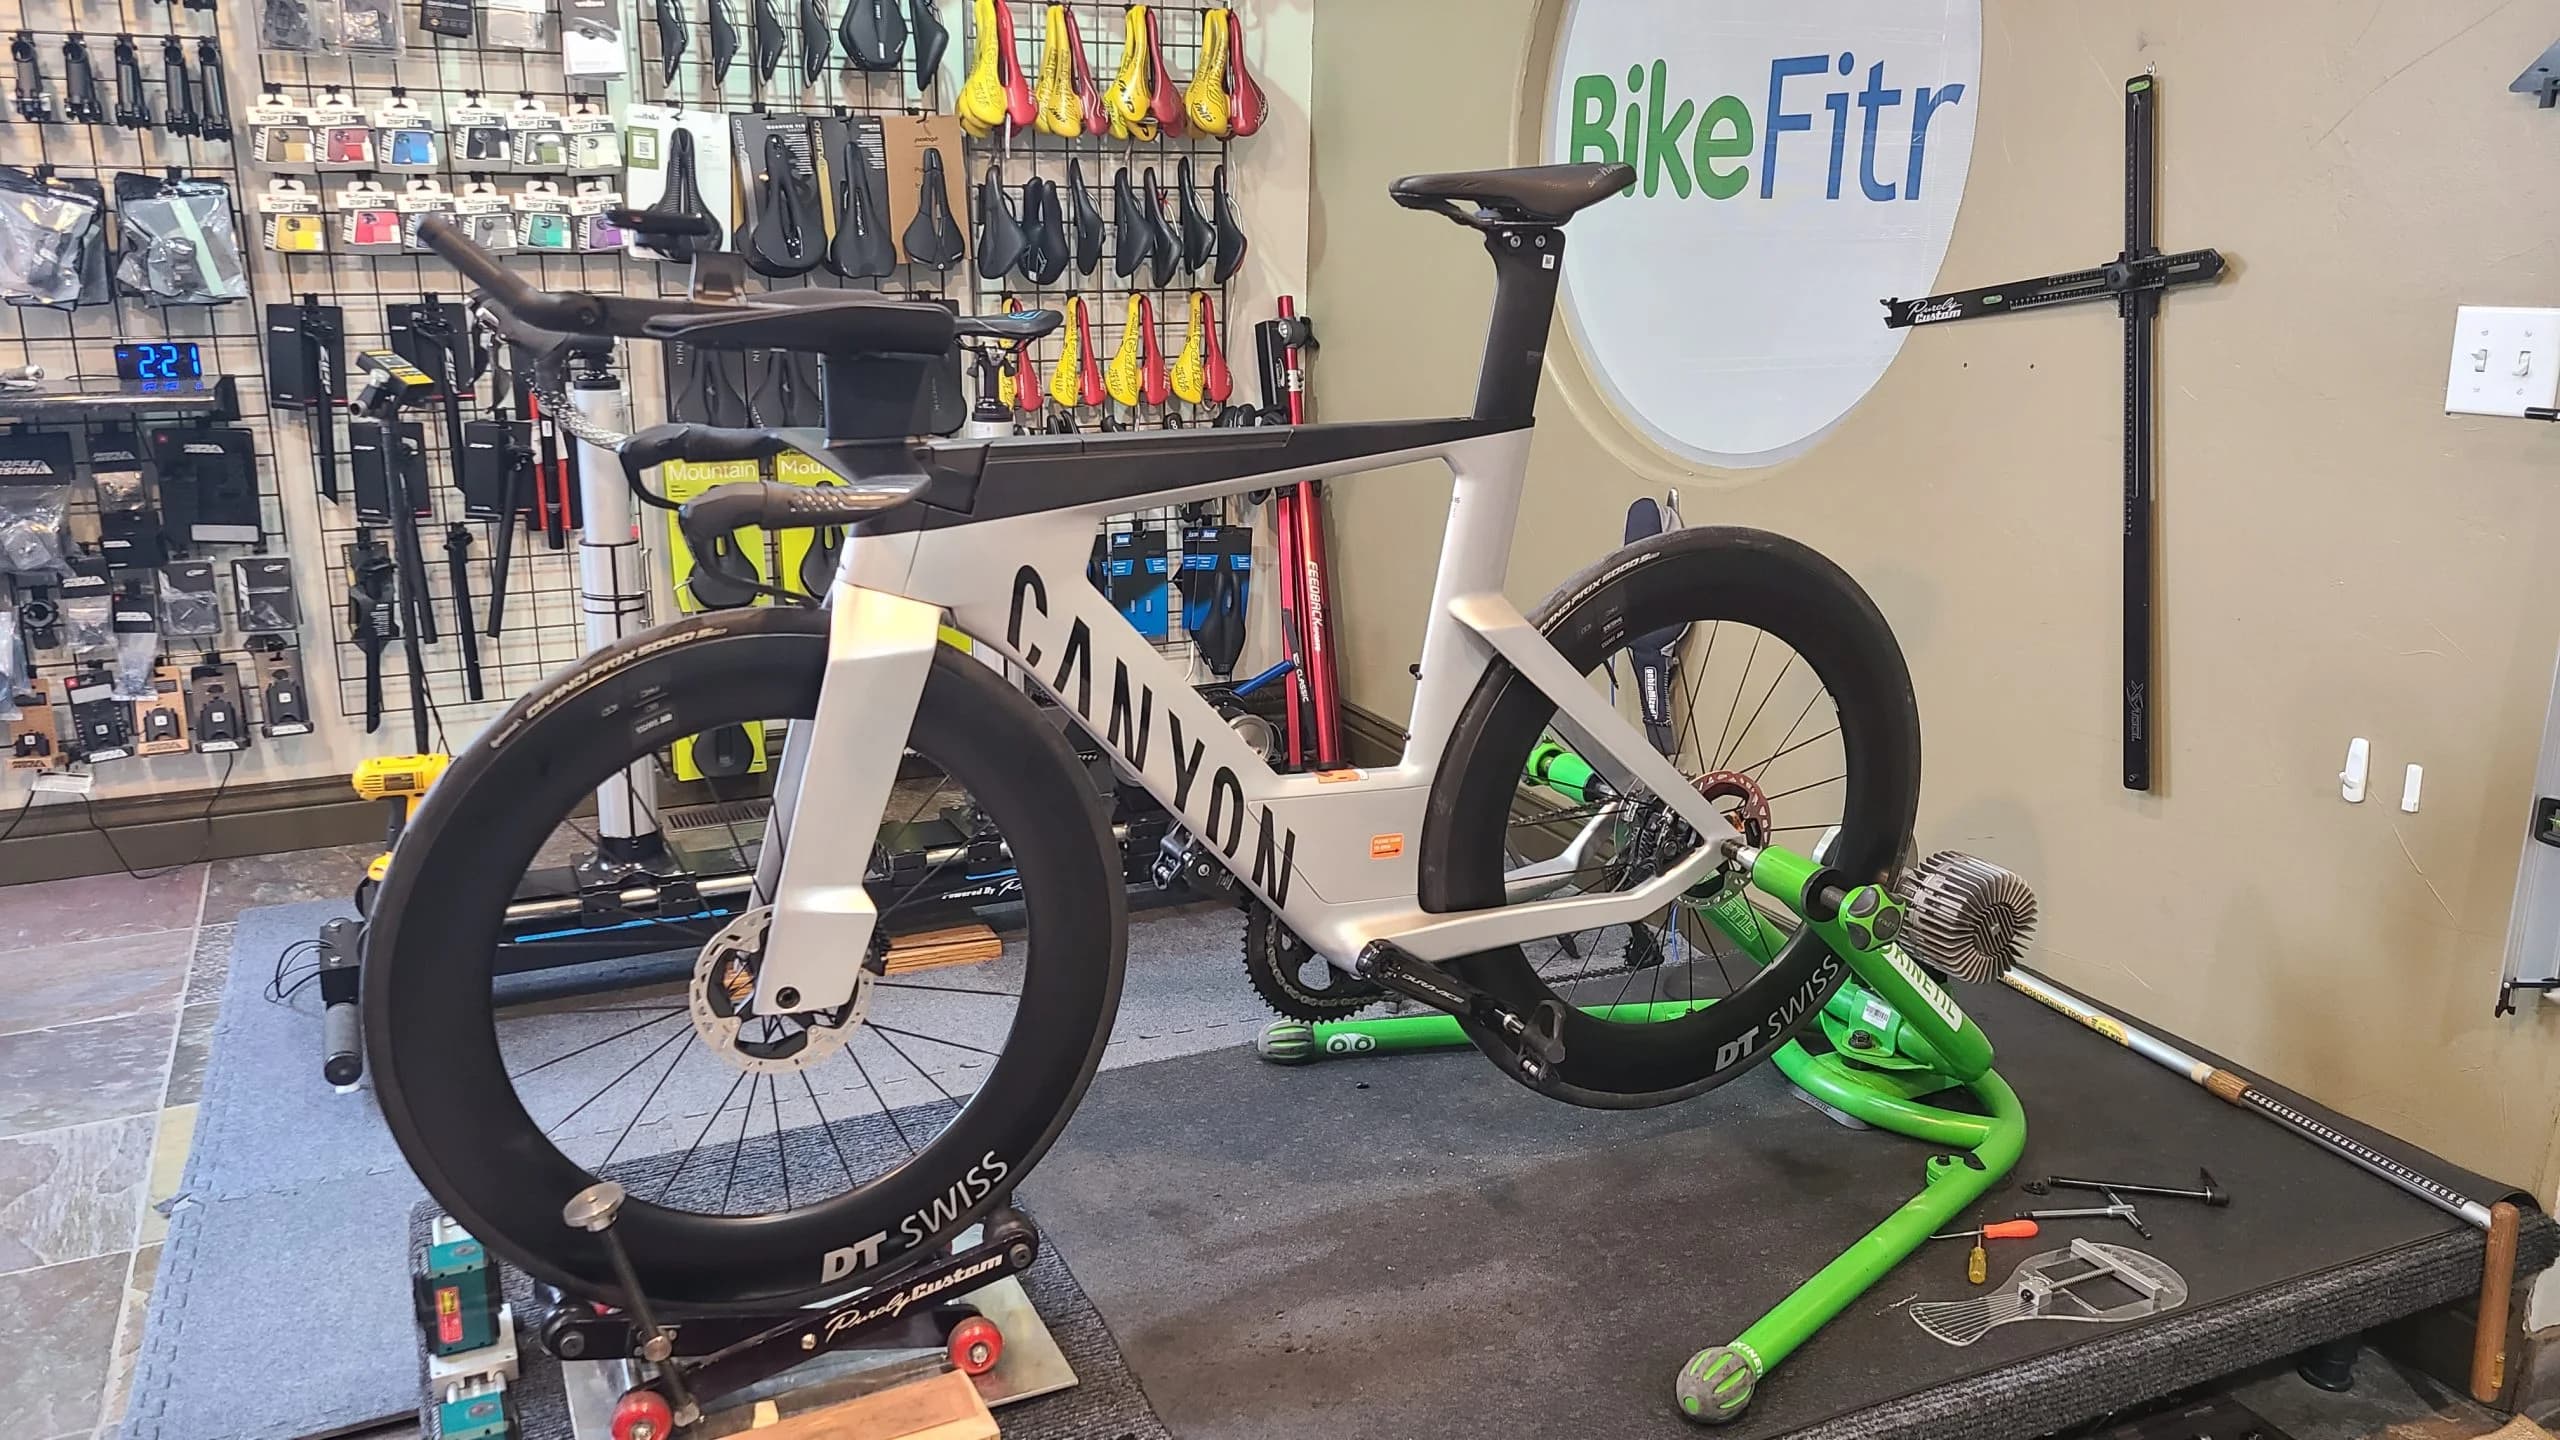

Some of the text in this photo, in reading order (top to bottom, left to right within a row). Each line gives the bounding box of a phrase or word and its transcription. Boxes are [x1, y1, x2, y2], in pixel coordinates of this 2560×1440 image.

[1570, 51, 1966, 202] BikeFitr
[1906, 296, 1963, 321] Purely
[1914, 309, 1962, 324] Custom
[138, 345, 200, 378] 2:21
[0, 467, 38, 475] ESIGN
[668, 463, 756, 481] Mountain
[1307, 560, 1324, 627] FEEDBACK
[1571, 577, 1602, 606] PRIX
[526, 671, 589, 719] GRAND
[588, 648, 638, 680] PRIX
[636, 630, 695, 657] 5000
[1296, 668, 1310, 703] CLASSIC
[1007, 564, 1296, 909] CANYON
[1719, 897, 1758, 938] ETIC
[1714, 1025, 1761, 1073] DT
[1767, 953, 1839, 1040] SWISS
[1893, 946, 1964, 1027] KINETIC
[821, 1149, 1008, 1284] DT SWISS
[824, 1253, 1003, 1344] Purely Custom
